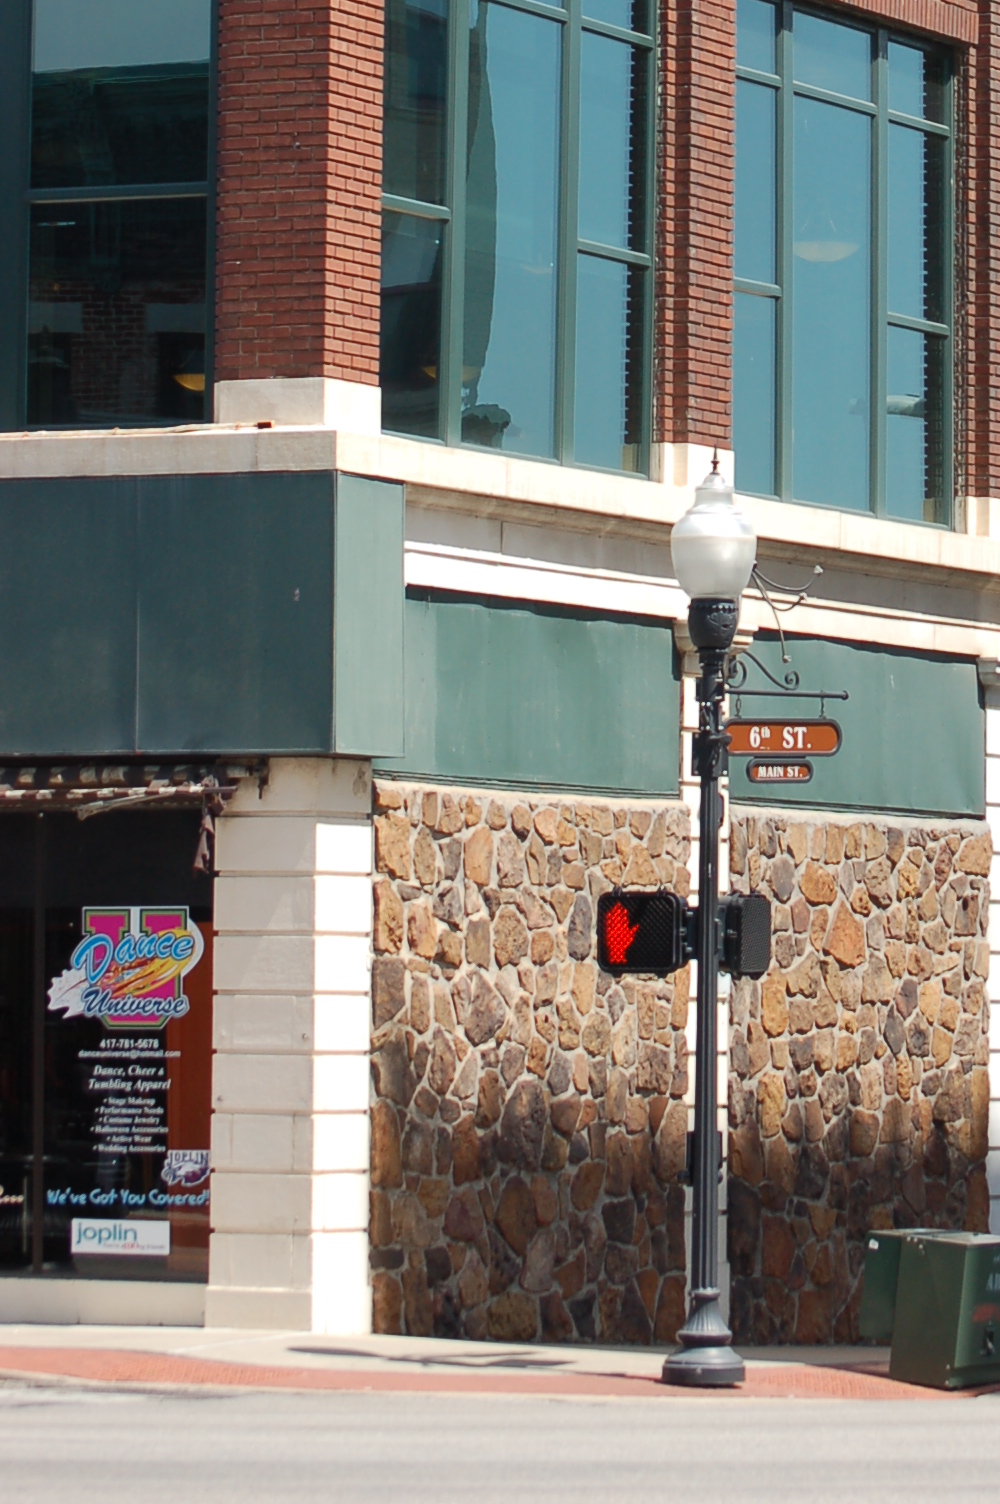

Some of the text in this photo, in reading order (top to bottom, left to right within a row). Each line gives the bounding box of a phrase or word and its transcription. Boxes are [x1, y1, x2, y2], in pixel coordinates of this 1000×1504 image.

[749, 726, 812, 749] 6th ST.
[757, 766, 803, 778] MAIN ST.
[72, 933, 194, 985] Dance
[83, 987, 187, 1016] Universe
[93, 1064, 126, 1076] Dance,
[128, 1064, 156, 1076] Cheer
[88, 1078, 172, 1092] Tumbling Apparel
[169, 1151, 210, 1167] JOPLIN
[47, 1187, 87, 1205] We've
[89, 1188, 119, 1205] Got
[120, 1189, 146, 1205] You
[76, 1222, 137, 1244] joplin
